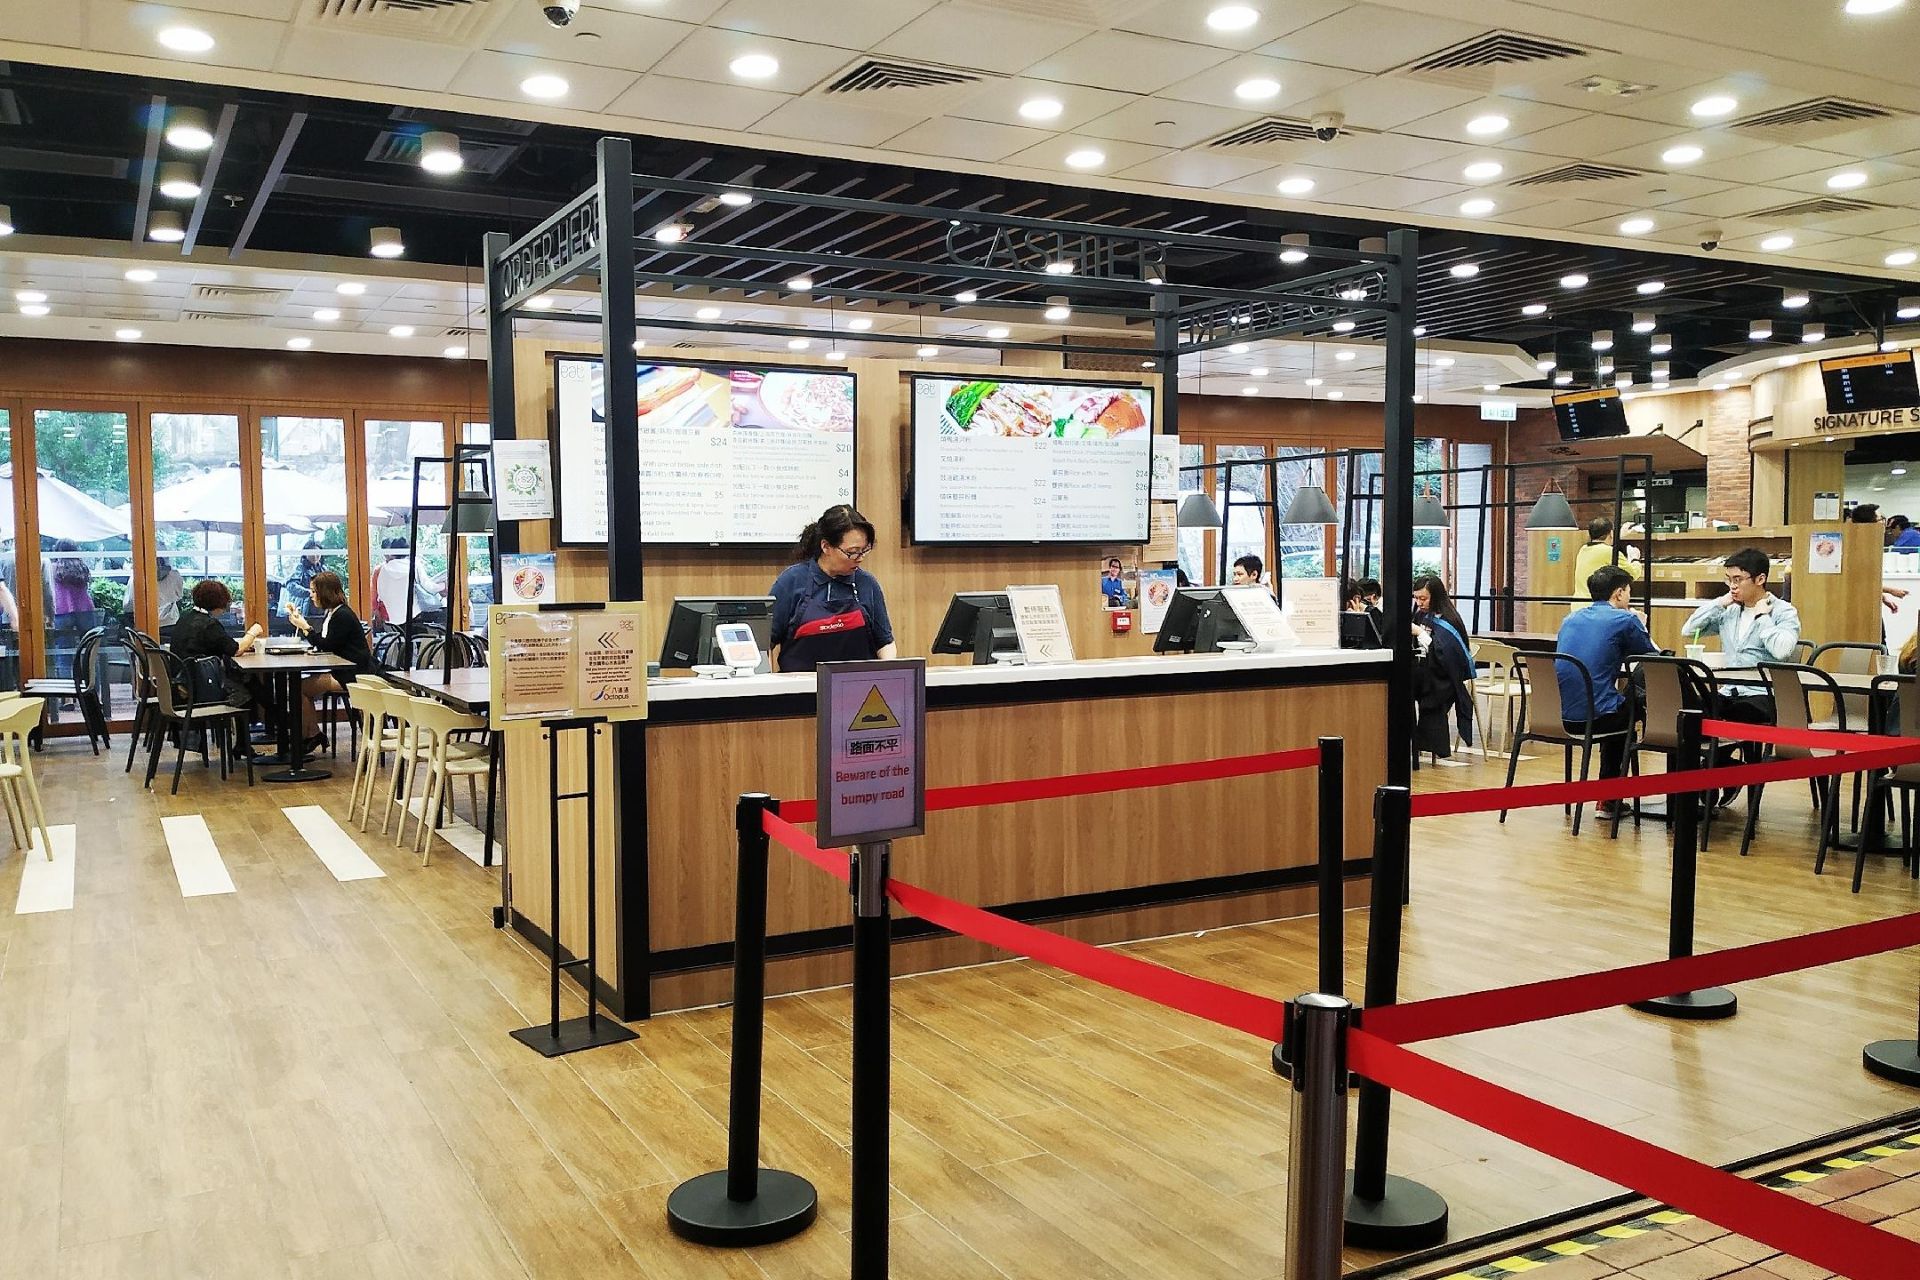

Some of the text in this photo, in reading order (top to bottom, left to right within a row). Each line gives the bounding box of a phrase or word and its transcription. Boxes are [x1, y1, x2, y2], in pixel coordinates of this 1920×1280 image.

[946, 222, 1167, 284] CASHIER
[502, 232, 555, 298] ORDER
[1813, 409, 1904, 431] SIGNATURE
[710, 437, 727, 447] $24
[1034, 441, 1047, 450] $22
[835, 443, 852, 453] $20
[838, 468, 849, 478] $4
[1135, 469, 1148, 478] $24
[1033, 479, 1047, 487] $22
[1135, 482, 1148, 491] $26
[1033, 497, 1047, 506] $24
[1134, 497, 1148, 506] $27
[850, 738, 899, 756] 路面不平
[835, 764, 910, 783] Beware of the
[841, 786, 905, 806] bumpy road
